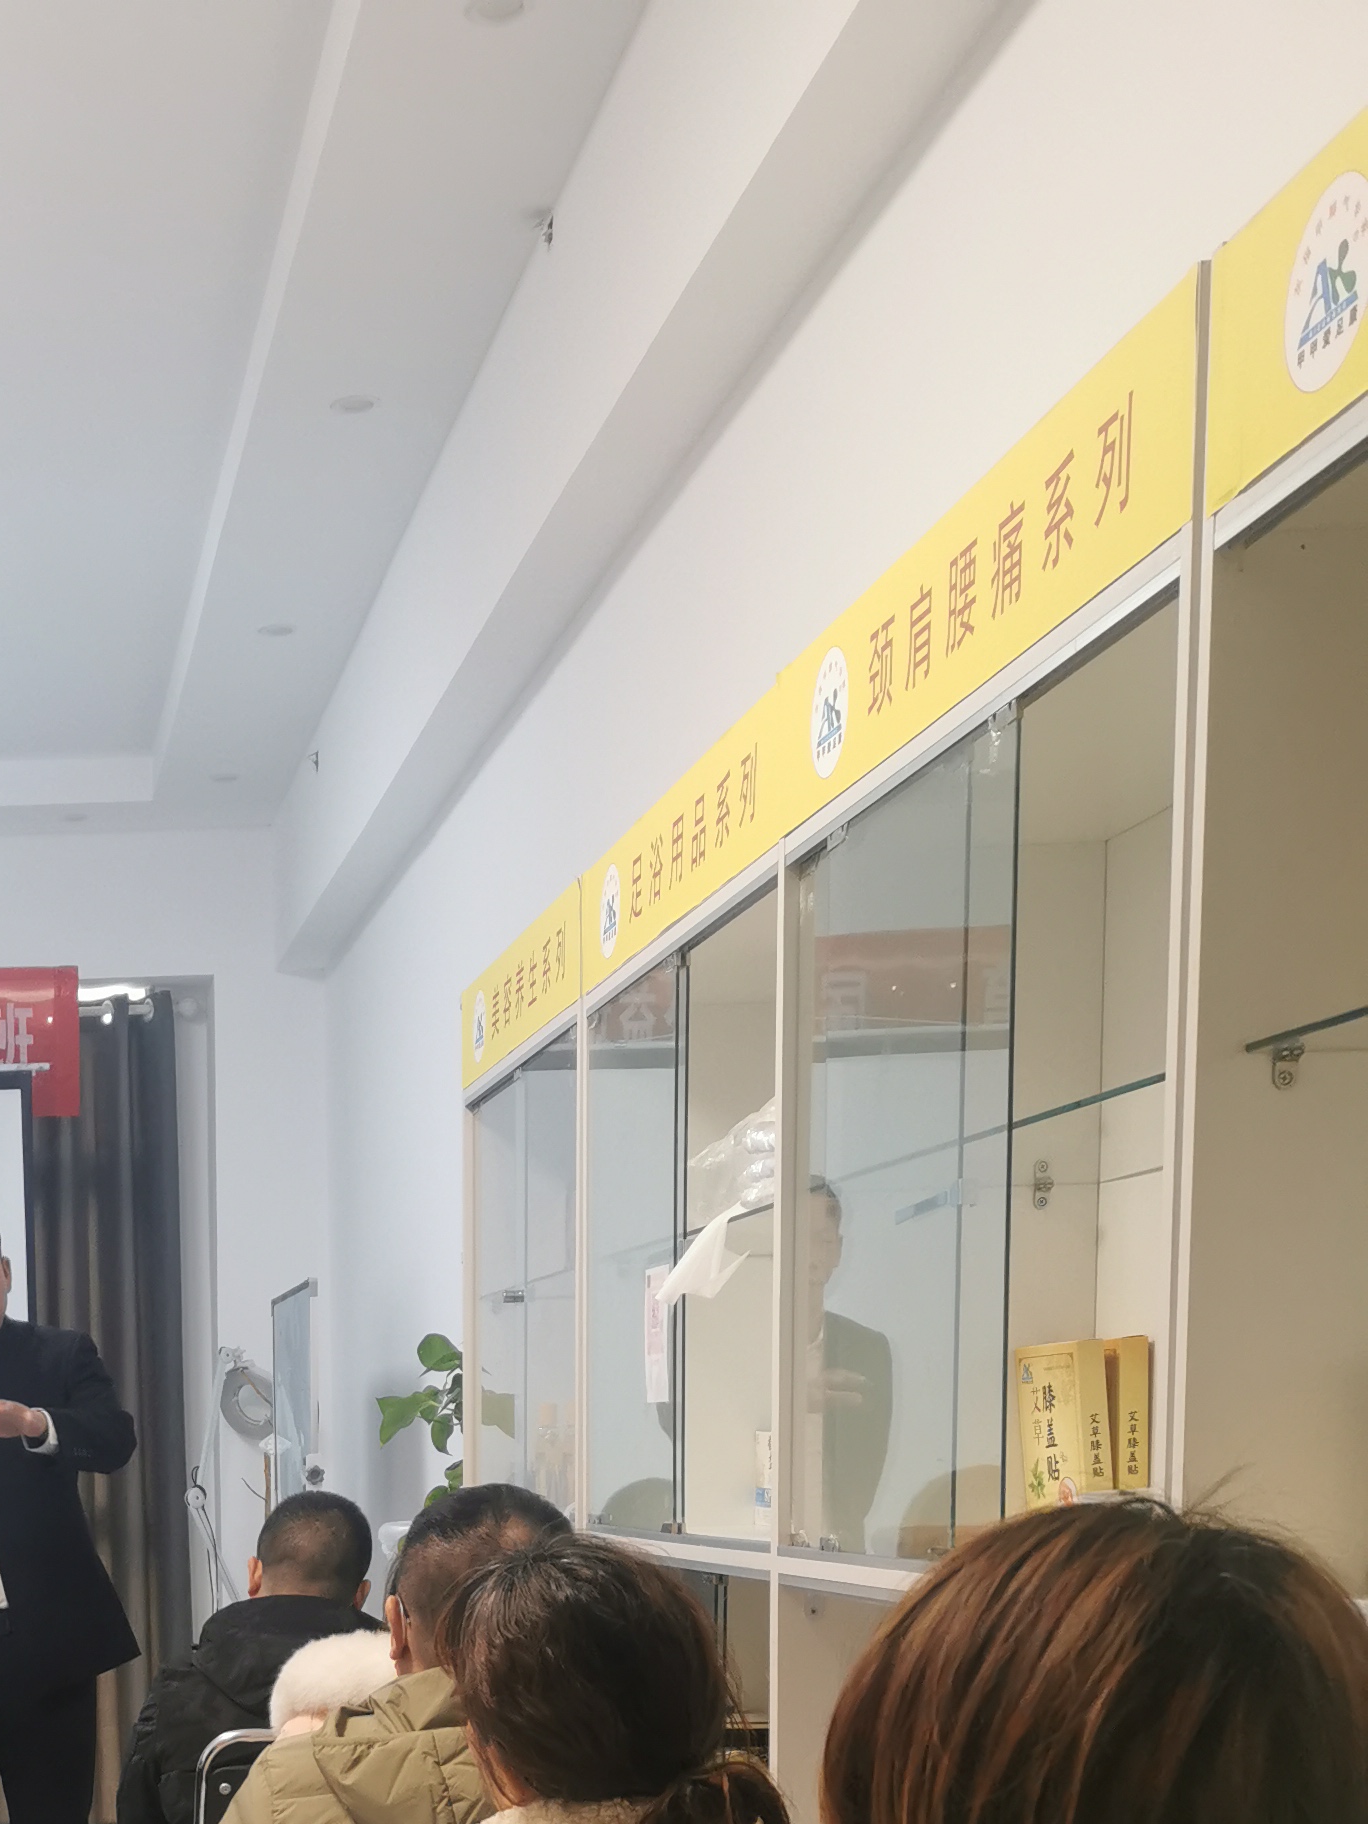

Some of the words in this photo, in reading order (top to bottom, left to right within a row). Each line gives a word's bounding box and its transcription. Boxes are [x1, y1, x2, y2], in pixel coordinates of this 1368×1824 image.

[867, 389, 1134, 717] 颈肩腰痛系列
[629, 742, 758, 924] 足浴用品系列
[491, 920, 567, 1040] 美容养生系列
[1030, 1386, 1044, 1446] 艾草
[1042, 1382, 1060, 1482] 膝盖贴
[1089, 1413, 1105, 1478] 艾草膝盖贴
[1127, 1411, 1140, 1475] 艾草膝盖贴
